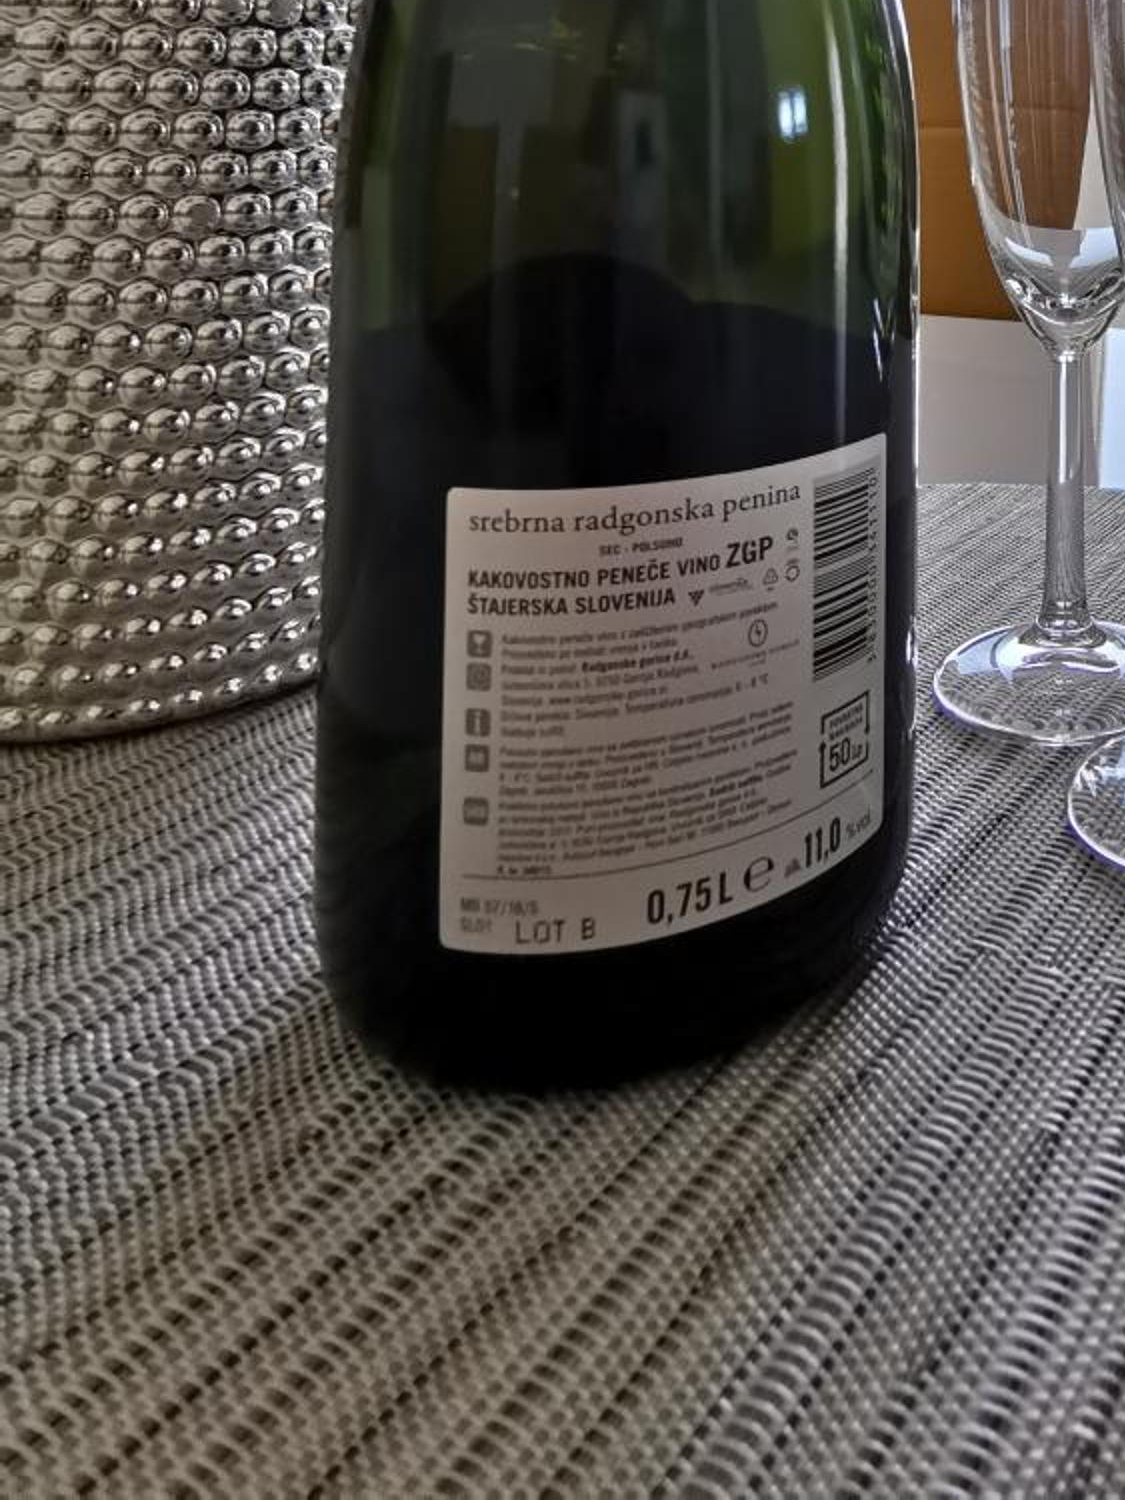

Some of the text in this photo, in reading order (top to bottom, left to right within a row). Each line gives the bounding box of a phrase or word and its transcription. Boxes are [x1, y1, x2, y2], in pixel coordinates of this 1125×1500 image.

[469, 485, 801, 536] srebrna radgonska penina
[468, 535, 774, 589] KAKOVOSTNO PENEČE VINO ZGP
[467, 587, 676, 616] ŠTAJERSKA SLOVENIJA
[829, 738, 851, 772] 50
[804, 816, 841, 867] 11,0
[515, 916, 596, 944] LOT B
